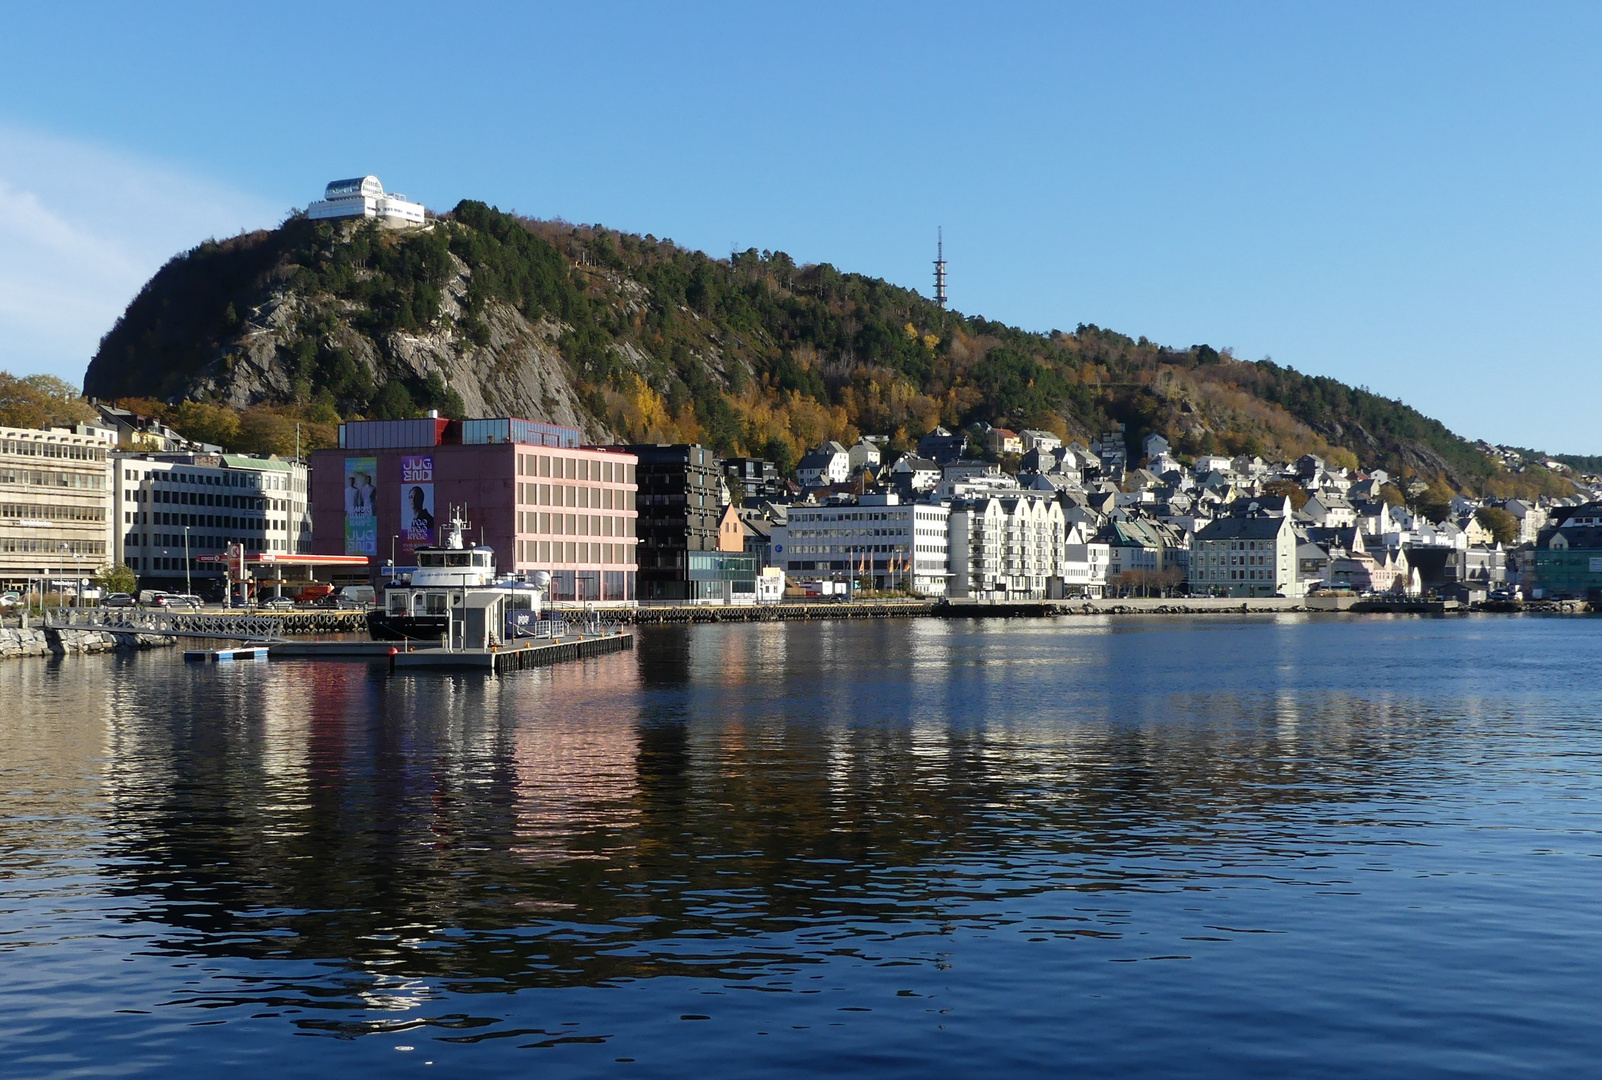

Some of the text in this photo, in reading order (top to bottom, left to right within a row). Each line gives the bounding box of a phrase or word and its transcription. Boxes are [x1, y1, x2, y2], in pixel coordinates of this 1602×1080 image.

[403, 458, 432, 470] JUG
[403, 470, 432, 481] END
[346, 529, 375, 540] JUG
[346, 541, 375, 552] END
